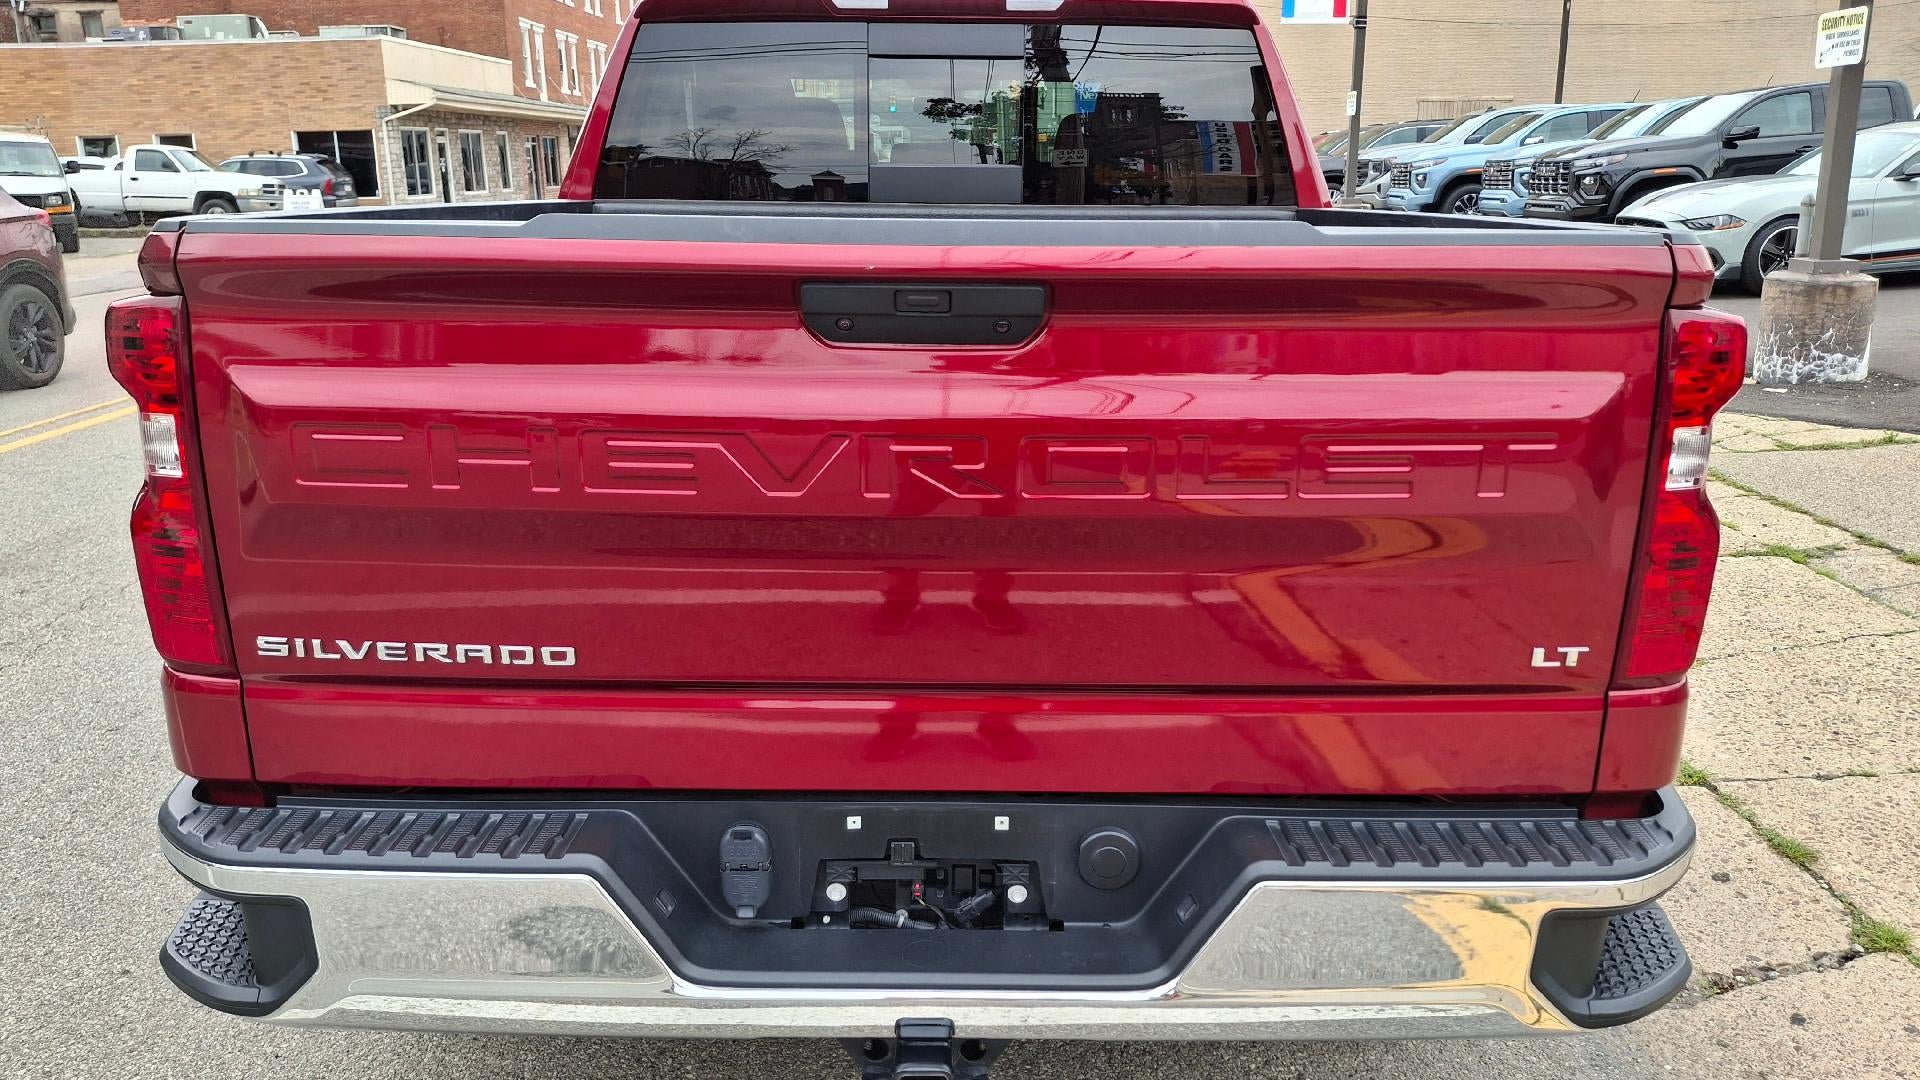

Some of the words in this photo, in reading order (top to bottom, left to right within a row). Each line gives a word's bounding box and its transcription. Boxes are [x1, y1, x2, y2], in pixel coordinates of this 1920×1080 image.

[1821, 16, 1846, 31] SECURITY
[1846, 12, 1864, 26] NOTICE
[289, 421, 1558, 500] CHEVROLET
[256, 635, 576, 666] SILVERADO
[1531, 646, 1590, 667] LT
